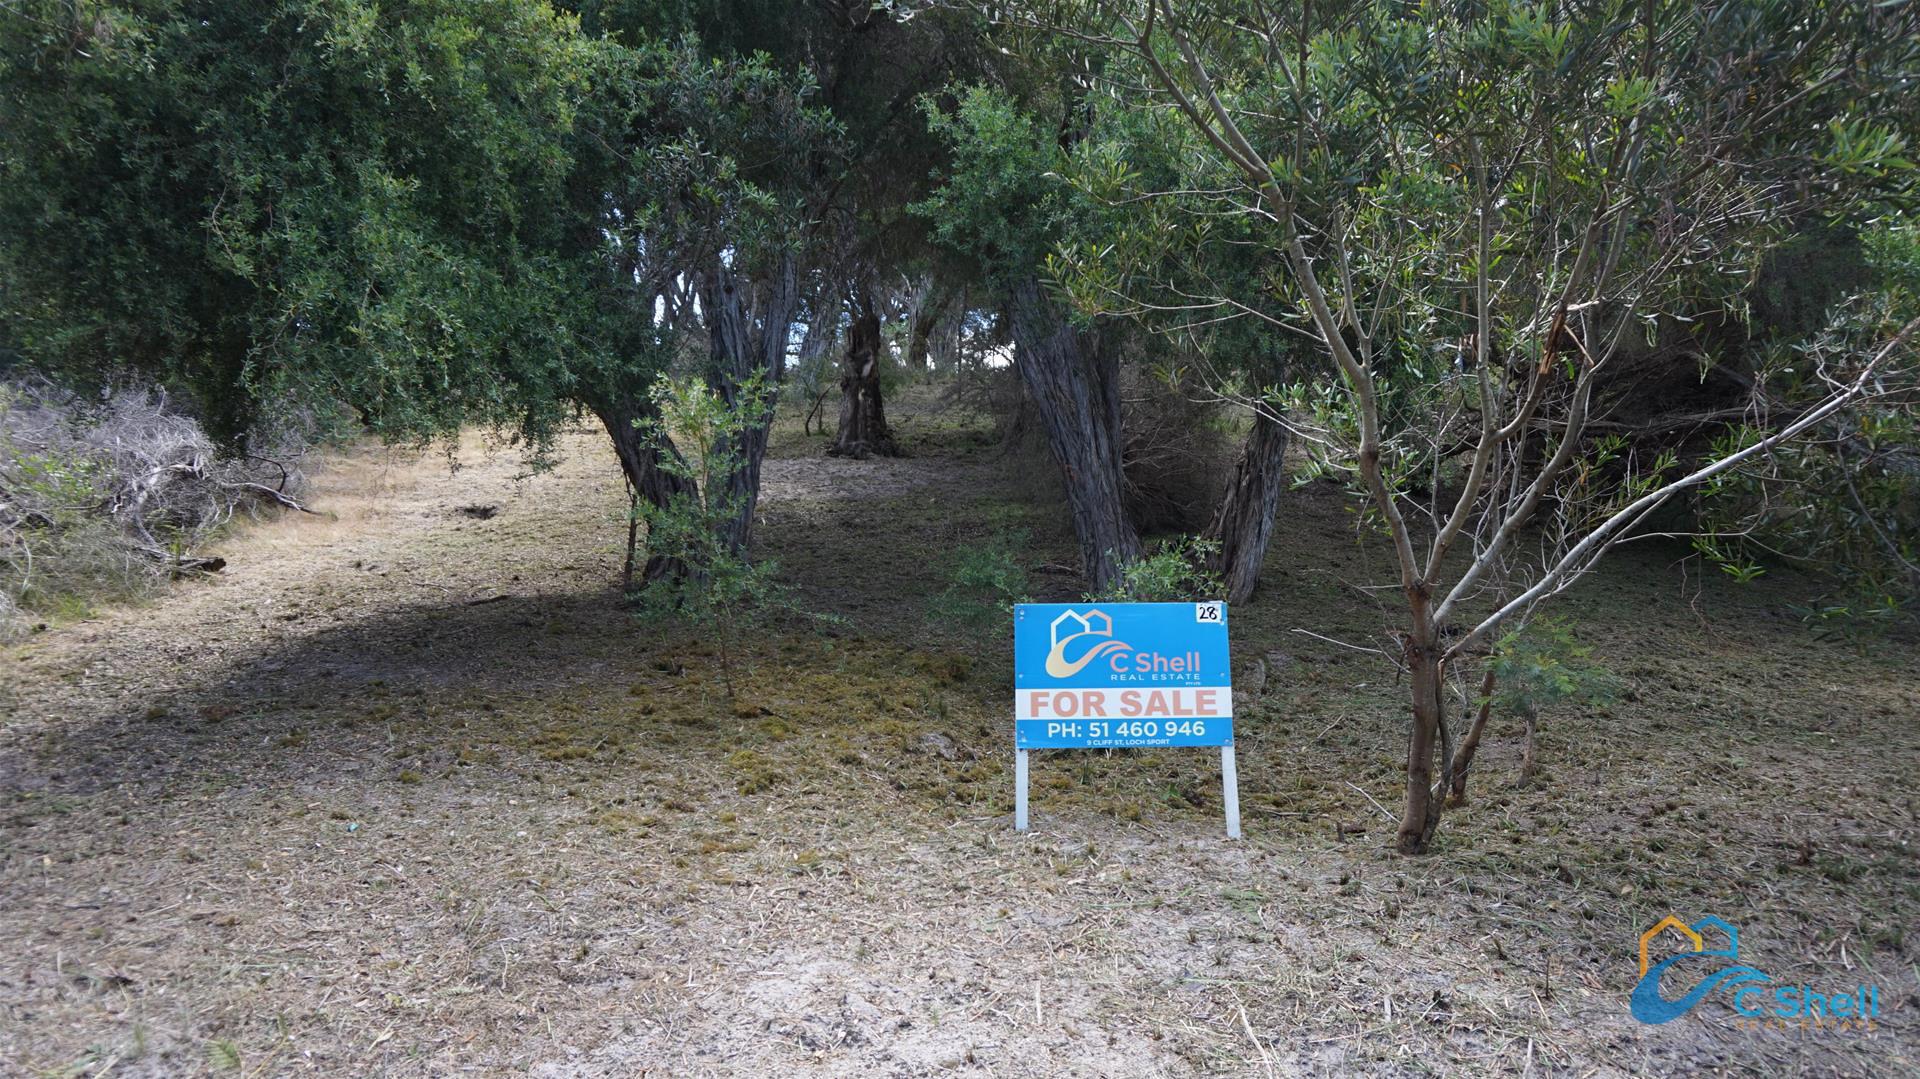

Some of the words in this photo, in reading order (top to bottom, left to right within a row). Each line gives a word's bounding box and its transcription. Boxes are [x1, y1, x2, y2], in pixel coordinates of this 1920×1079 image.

[1199, 606, 1217, 620] 28
[1109, 652, 1129, 673] C
[1135, 651, 1201, 673] Shell
[1151, 673, 1201, 681] ESTATE
[1030, 691, 1107, 718] FOR
[1120, 690, 1217, 716] SALE
[1047, 723, 1082, 738] PH:
[1089, 722, 1109, 737] 51
[1116, 722, 1158, 737] 460
[1165, 721, 1205, 737] 946
